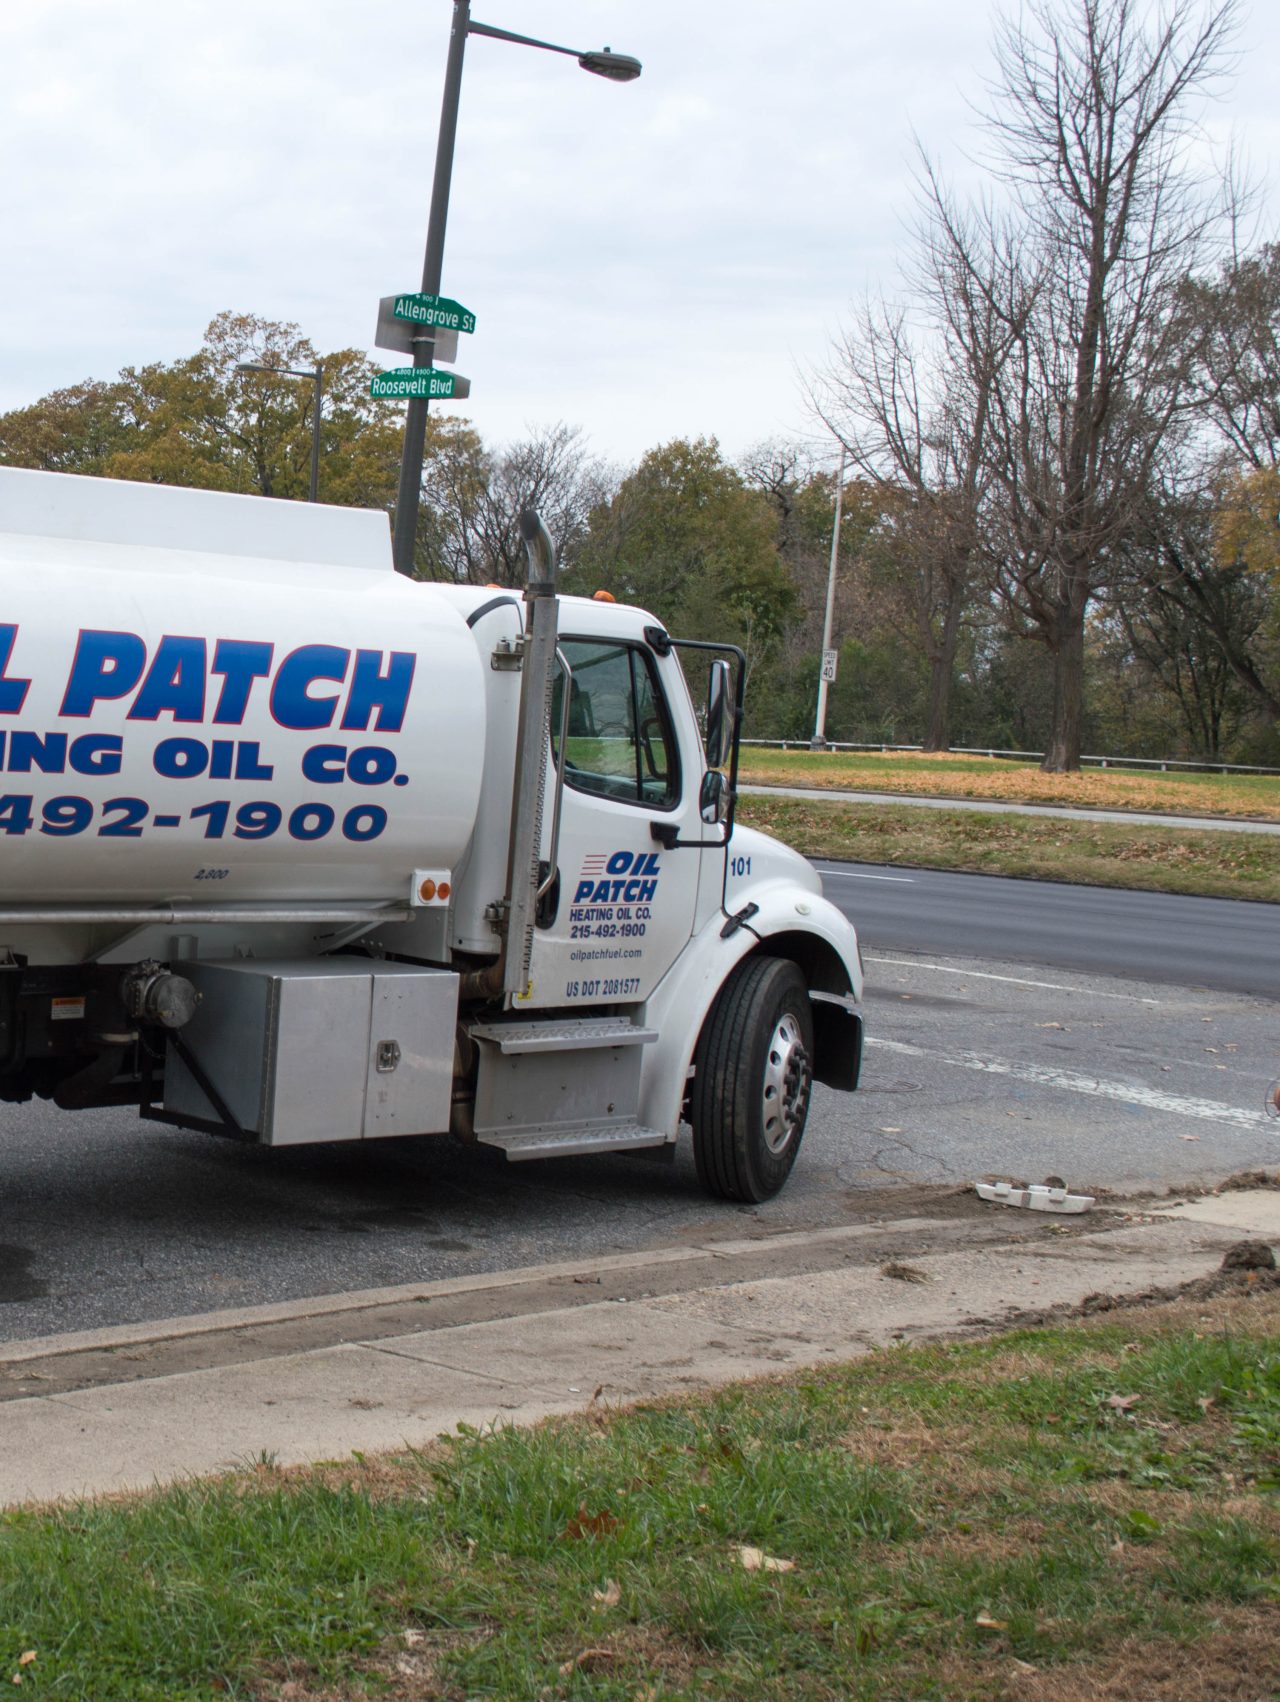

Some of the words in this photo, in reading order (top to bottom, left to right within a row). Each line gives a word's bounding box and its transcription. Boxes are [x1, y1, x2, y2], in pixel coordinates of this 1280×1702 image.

[395, 298, 459, 327] Allengrove
[462, 315, 473, 330] St
[372, 377, 426, 394] Roosevelt
[429, 379, 453, 394] Blvd
[58, 628, 417, 733] PATCH
[823, 667, 834, 679] 40
[153, 737, 274, 781] OIL
[301, 744, 410, 787] CO.
[606, 851, 660, 876] OIL
[731, 857, 751, 876] 101
[194, 868, 228, 881] 2,800
[573, 879, 658, 903] PATCH
[570, 907, 613, 922] HEATING
[616, 907, 632, 920] OIL
[635, 906, 652, 919] CO.
[570, 923, 646, 939] 215-492-1900
[570, 948, 642, 962] oilpatchfuel.com
[566, 981, 579, 997] US
[581, 979, 601, 996] DOT
[602, 978, 640, 994] 2081577
